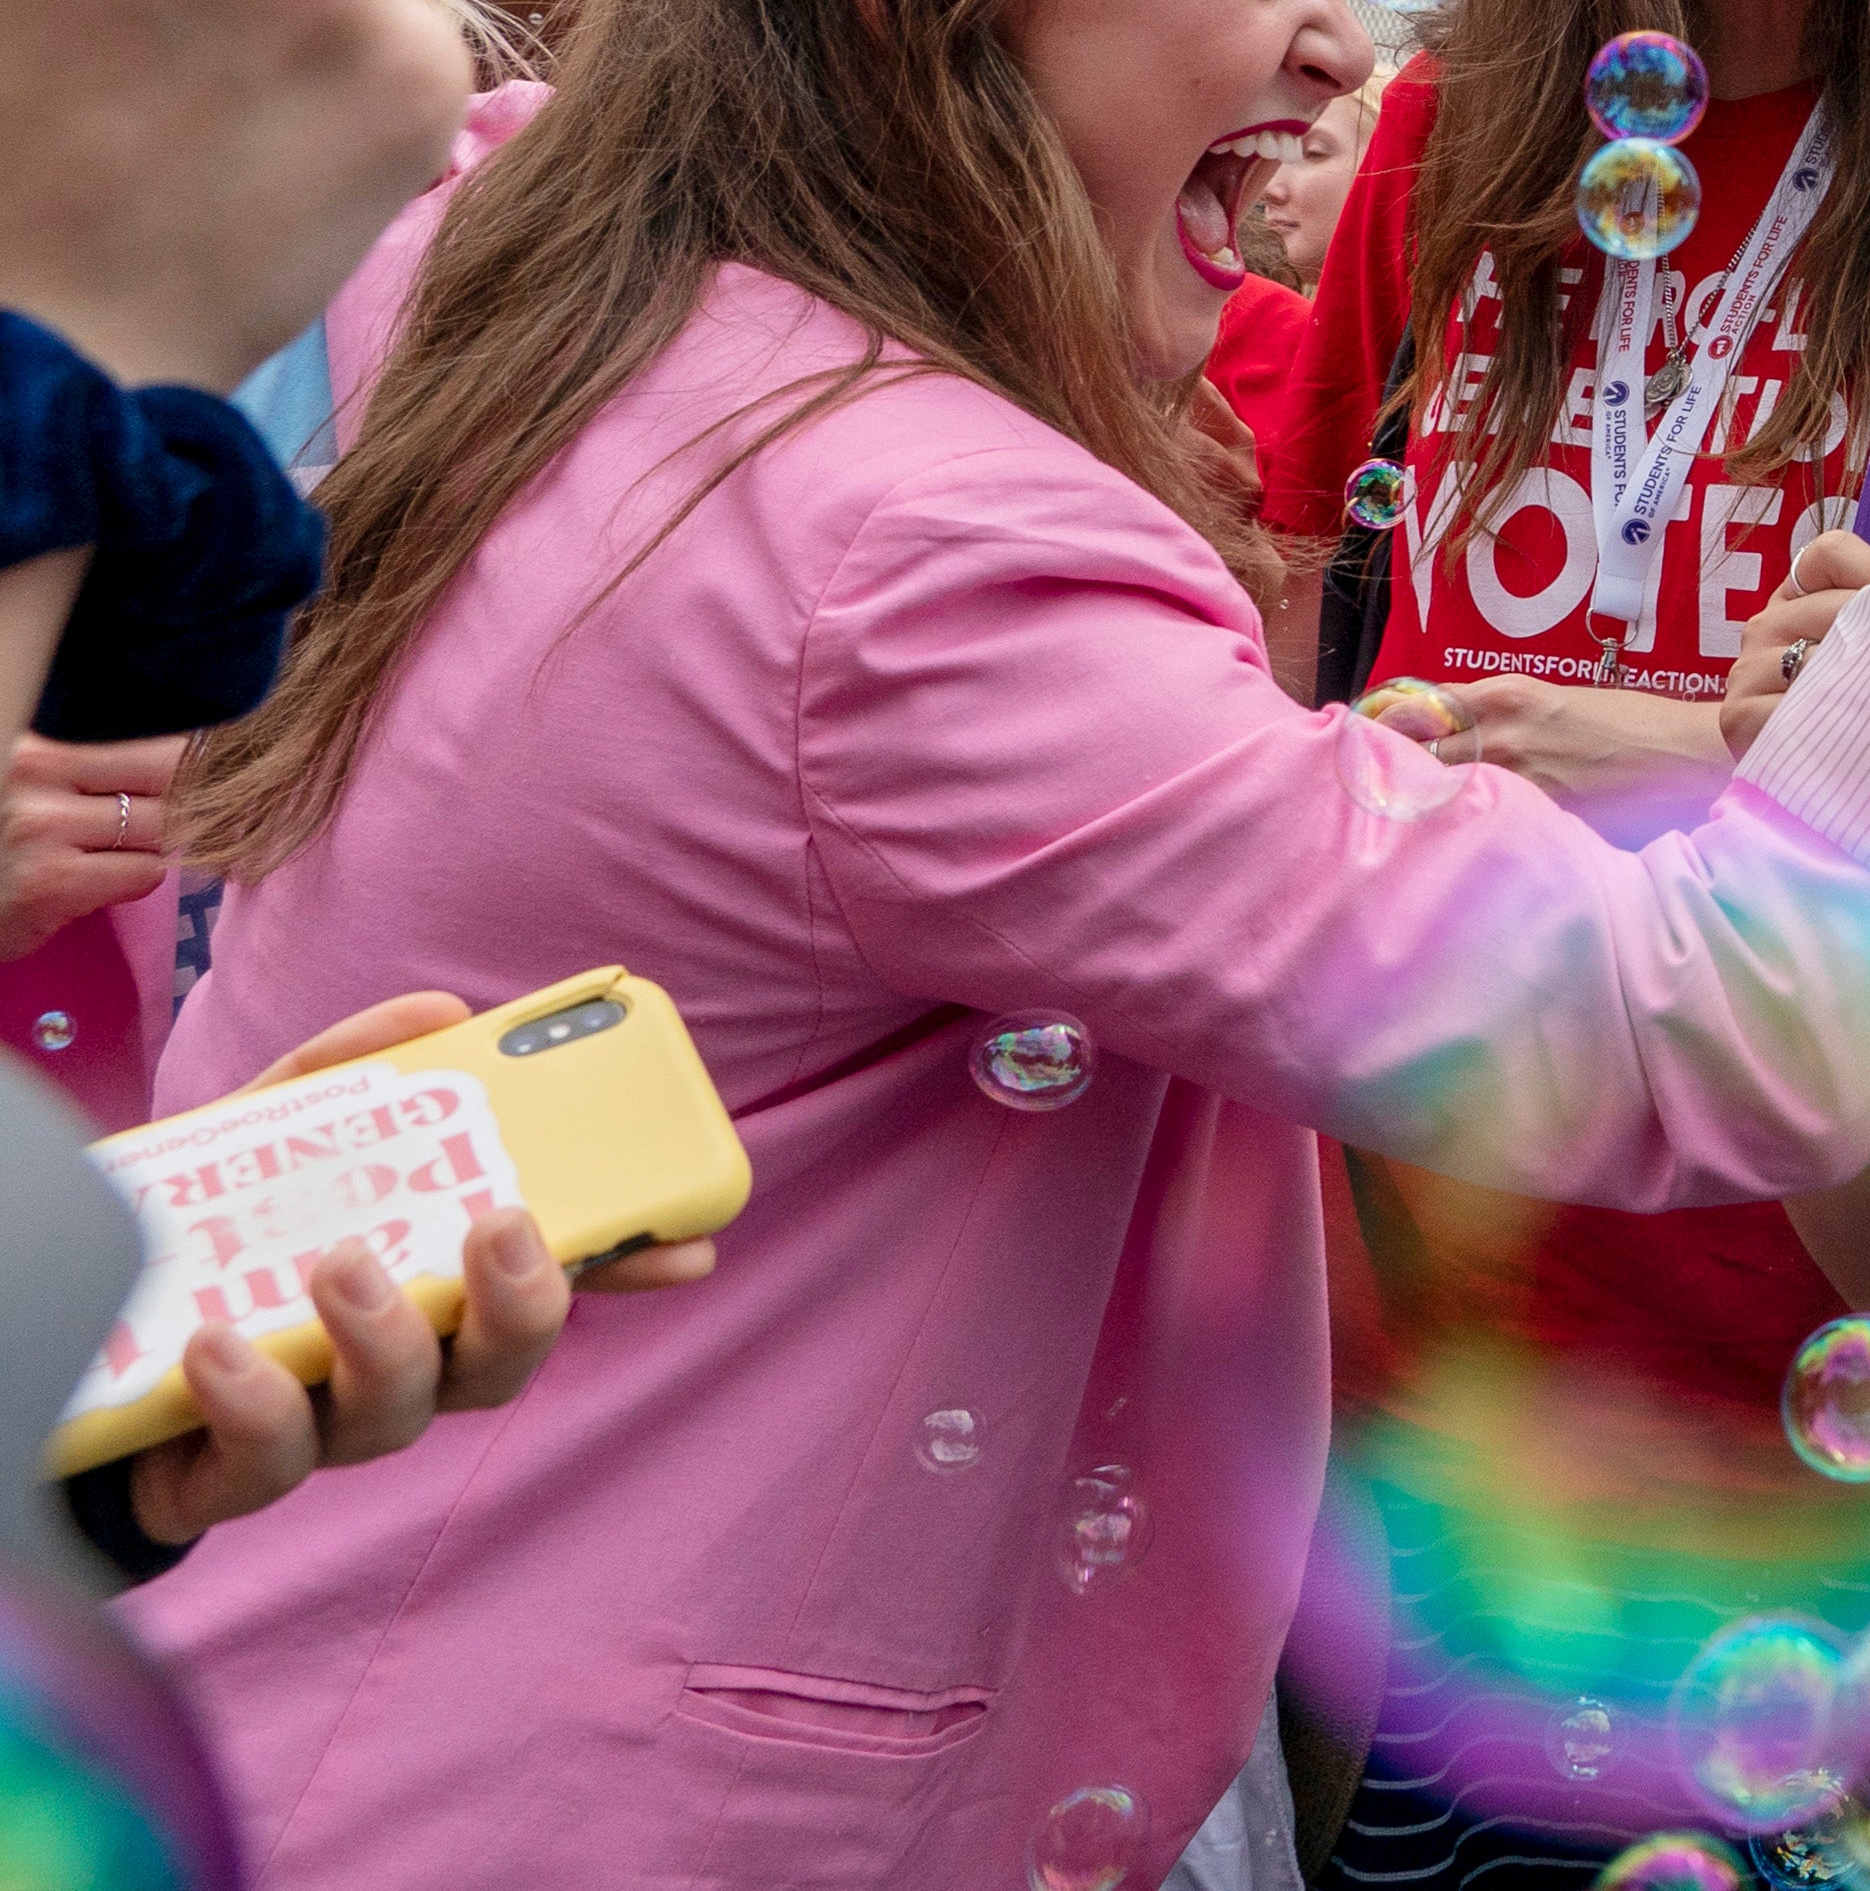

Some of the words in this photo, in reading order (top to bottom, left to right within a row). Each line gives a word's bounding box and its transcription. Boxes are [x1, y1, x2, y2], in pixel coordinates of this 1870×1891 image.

[1720, 271, 1760, 334] STUDENTS
[1753, 242, 1775, 273] FOR
[1767, 215, 1788, 245] LIFE
[1617, 327, 1634, 353] LIFE
[1621, 300, 1636, 327] FOR
[1731, 293, 1757, 336] ACTION
[1613, 409, 1627, 480] STUDENTS
[1634, 445, 1674, 516] STUDENTS
[1667, 414, 1688, 443] FOR
[1684, 384, 1703, 413] LIFE
